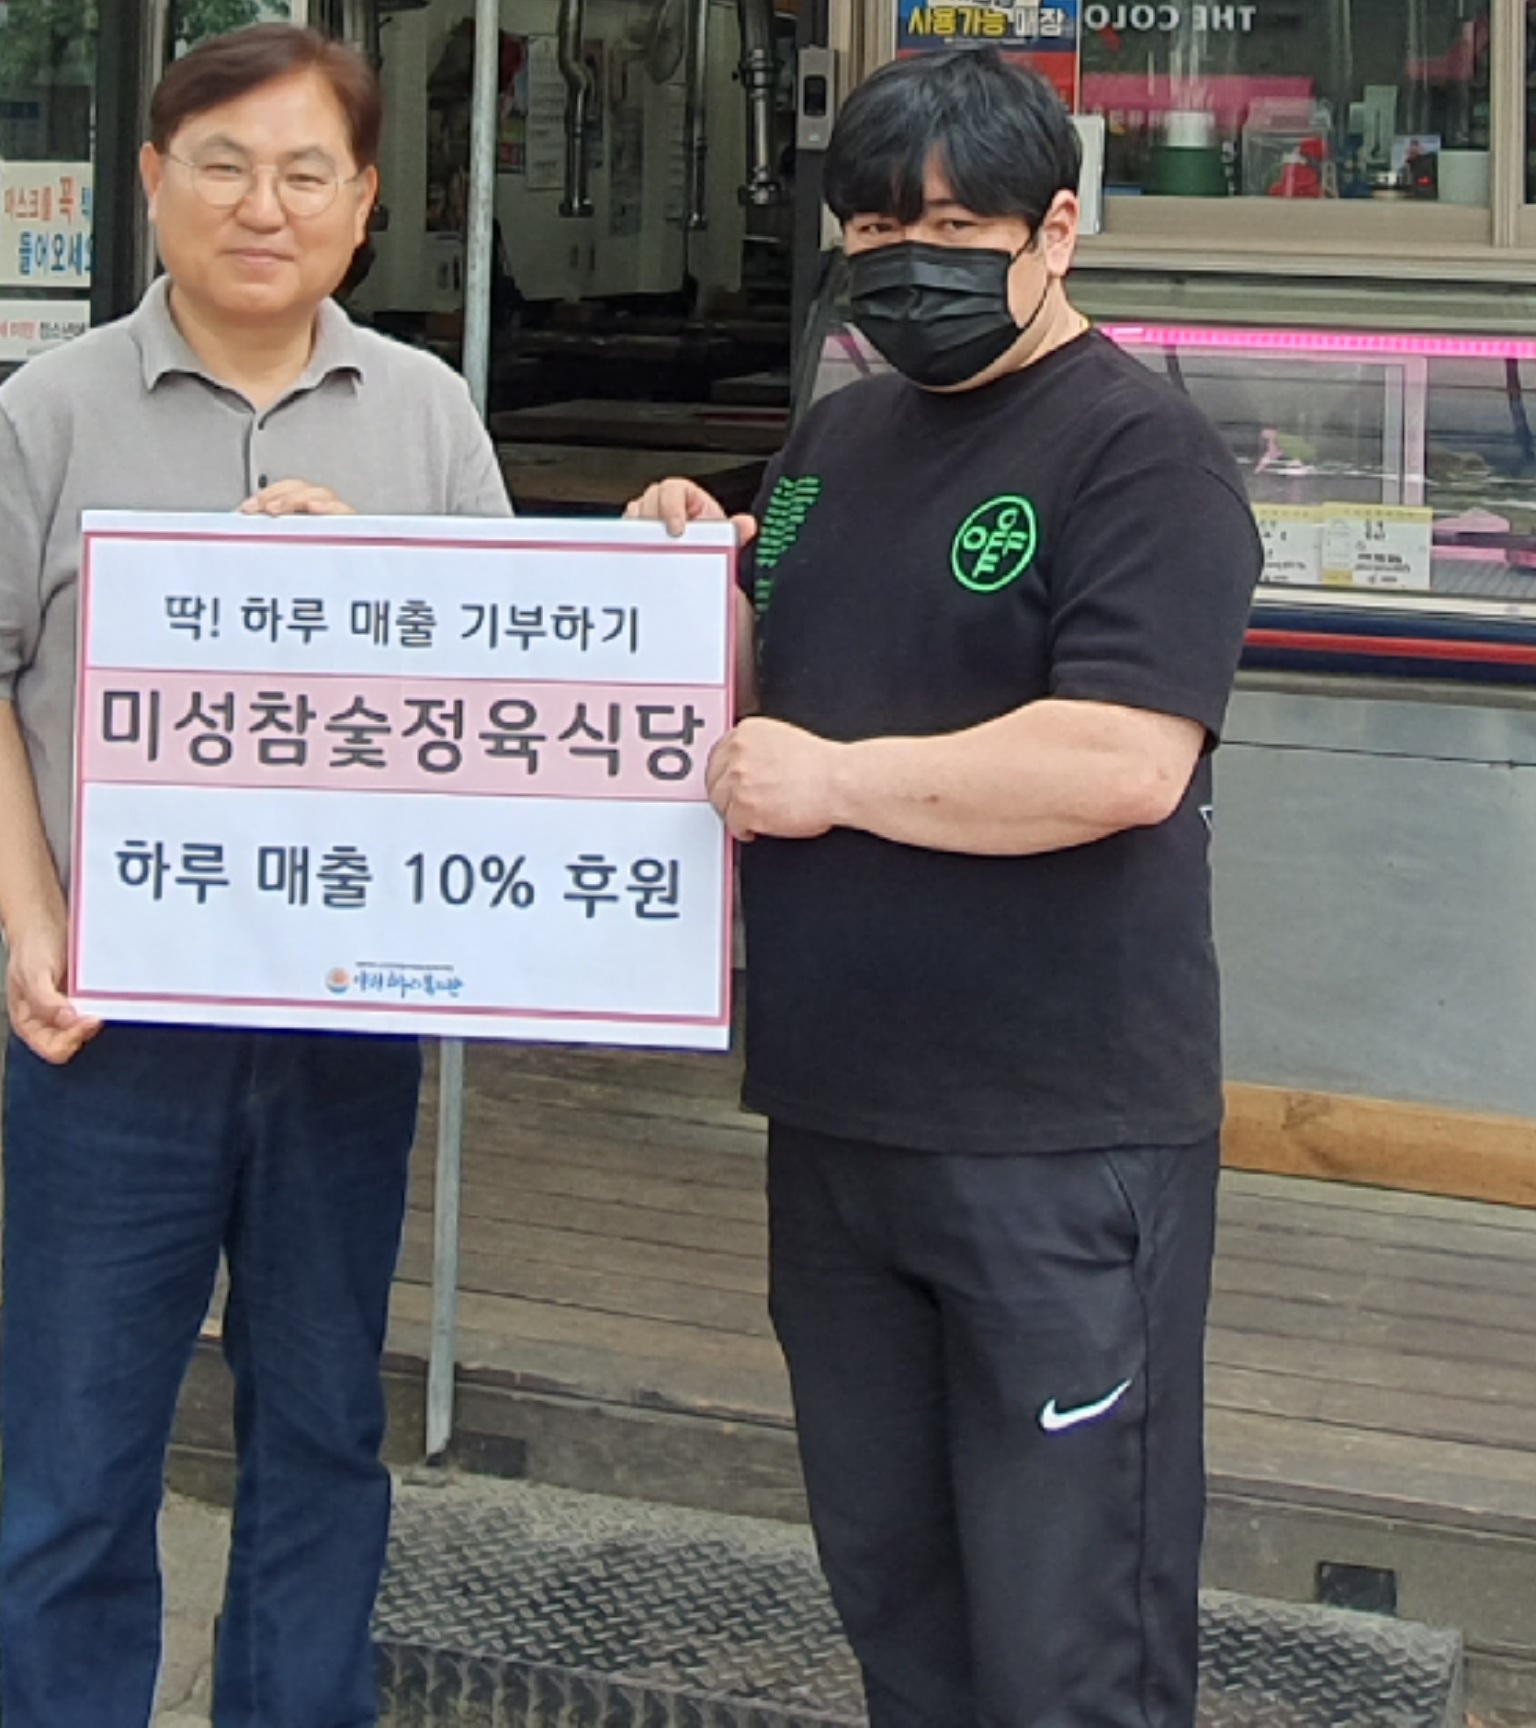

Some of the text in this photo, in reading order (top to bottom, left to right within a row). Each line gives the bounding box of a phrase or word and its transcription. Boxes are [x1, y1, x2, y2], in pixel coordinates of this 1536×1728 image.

[909, 6, 1066, 39] 사용가능 매장
[165, 595, 641, 653] 딱! 하루 매출 기부하기
[102, 688, 706, 783] 미성참숯정육식당
[114, 838, 682, 920] 하루 매출 10% 후원
